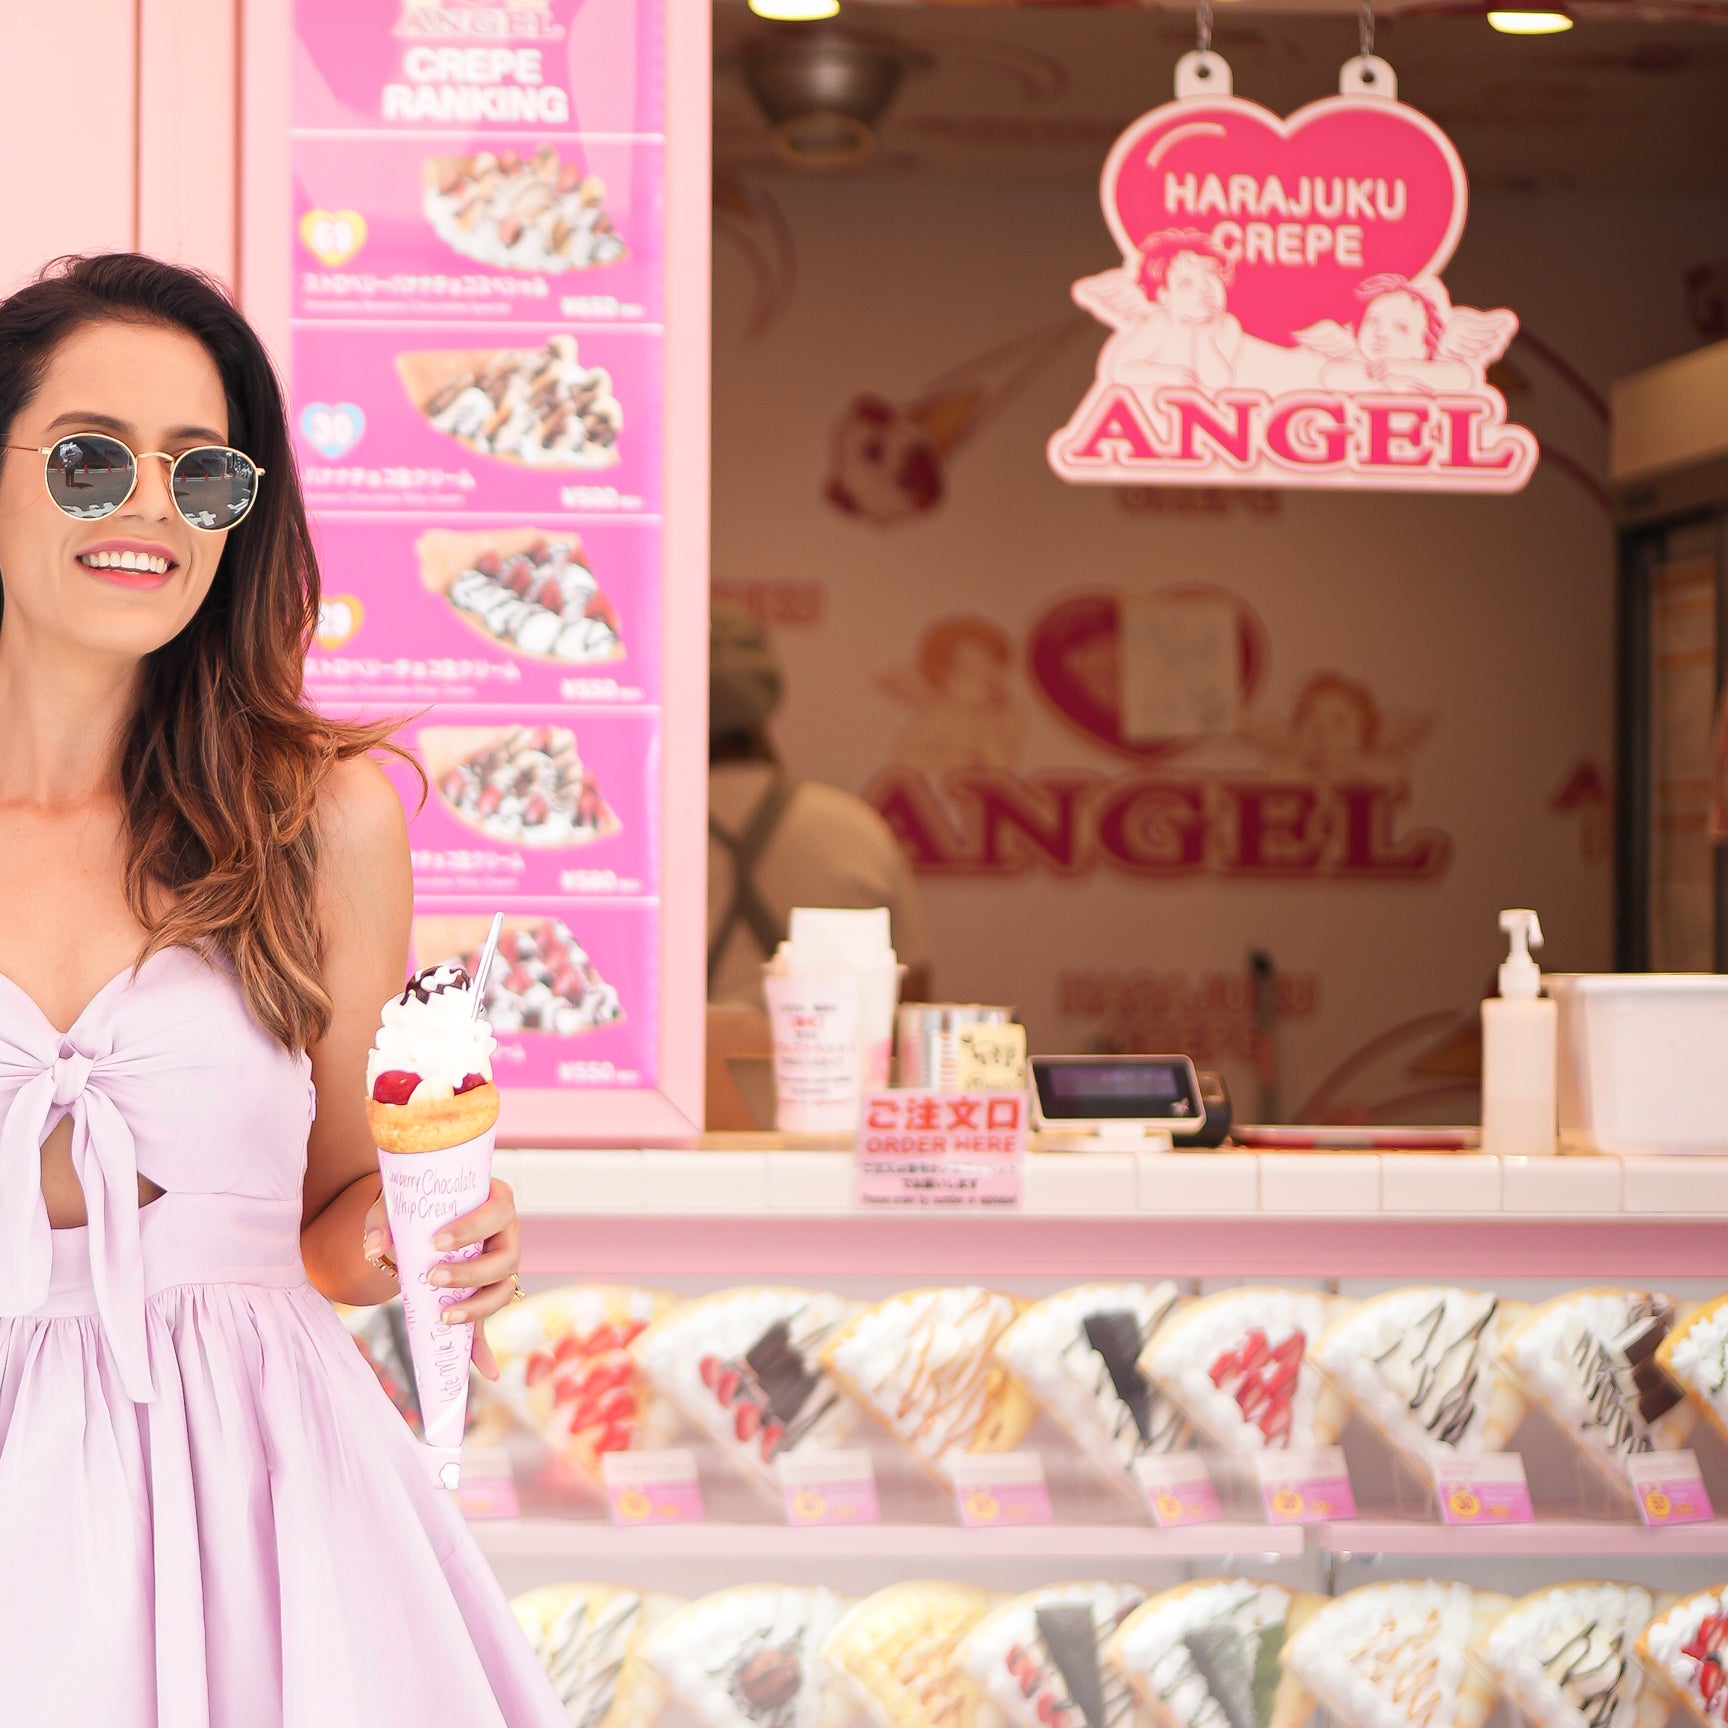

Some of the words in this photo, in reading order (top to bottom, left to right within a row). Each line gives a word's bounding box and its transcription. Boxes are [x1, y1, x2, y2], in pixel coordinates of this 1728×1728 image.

[402, 47, 543, 84] CREPE
[381, 83, 569, 124] RANKING
[1163, 171, 1408, 221] HARAJUKU
[1213, 220, 1365, 267] CREPE
[1072, 393, 1519, 472] ANGEL
[877, 772, 1452, 880] ANGEL
[867, 1095, 1021, 1131] ご注文口
[866, 1136, 947, 1153] ORDER
[954, 1136, 1016, 1153] HERE
[421, 1167, 477, 1196] Chocolate
[393, 1191, 417, 1222] Whip
[418, 1196, 459, 1219] Cream
